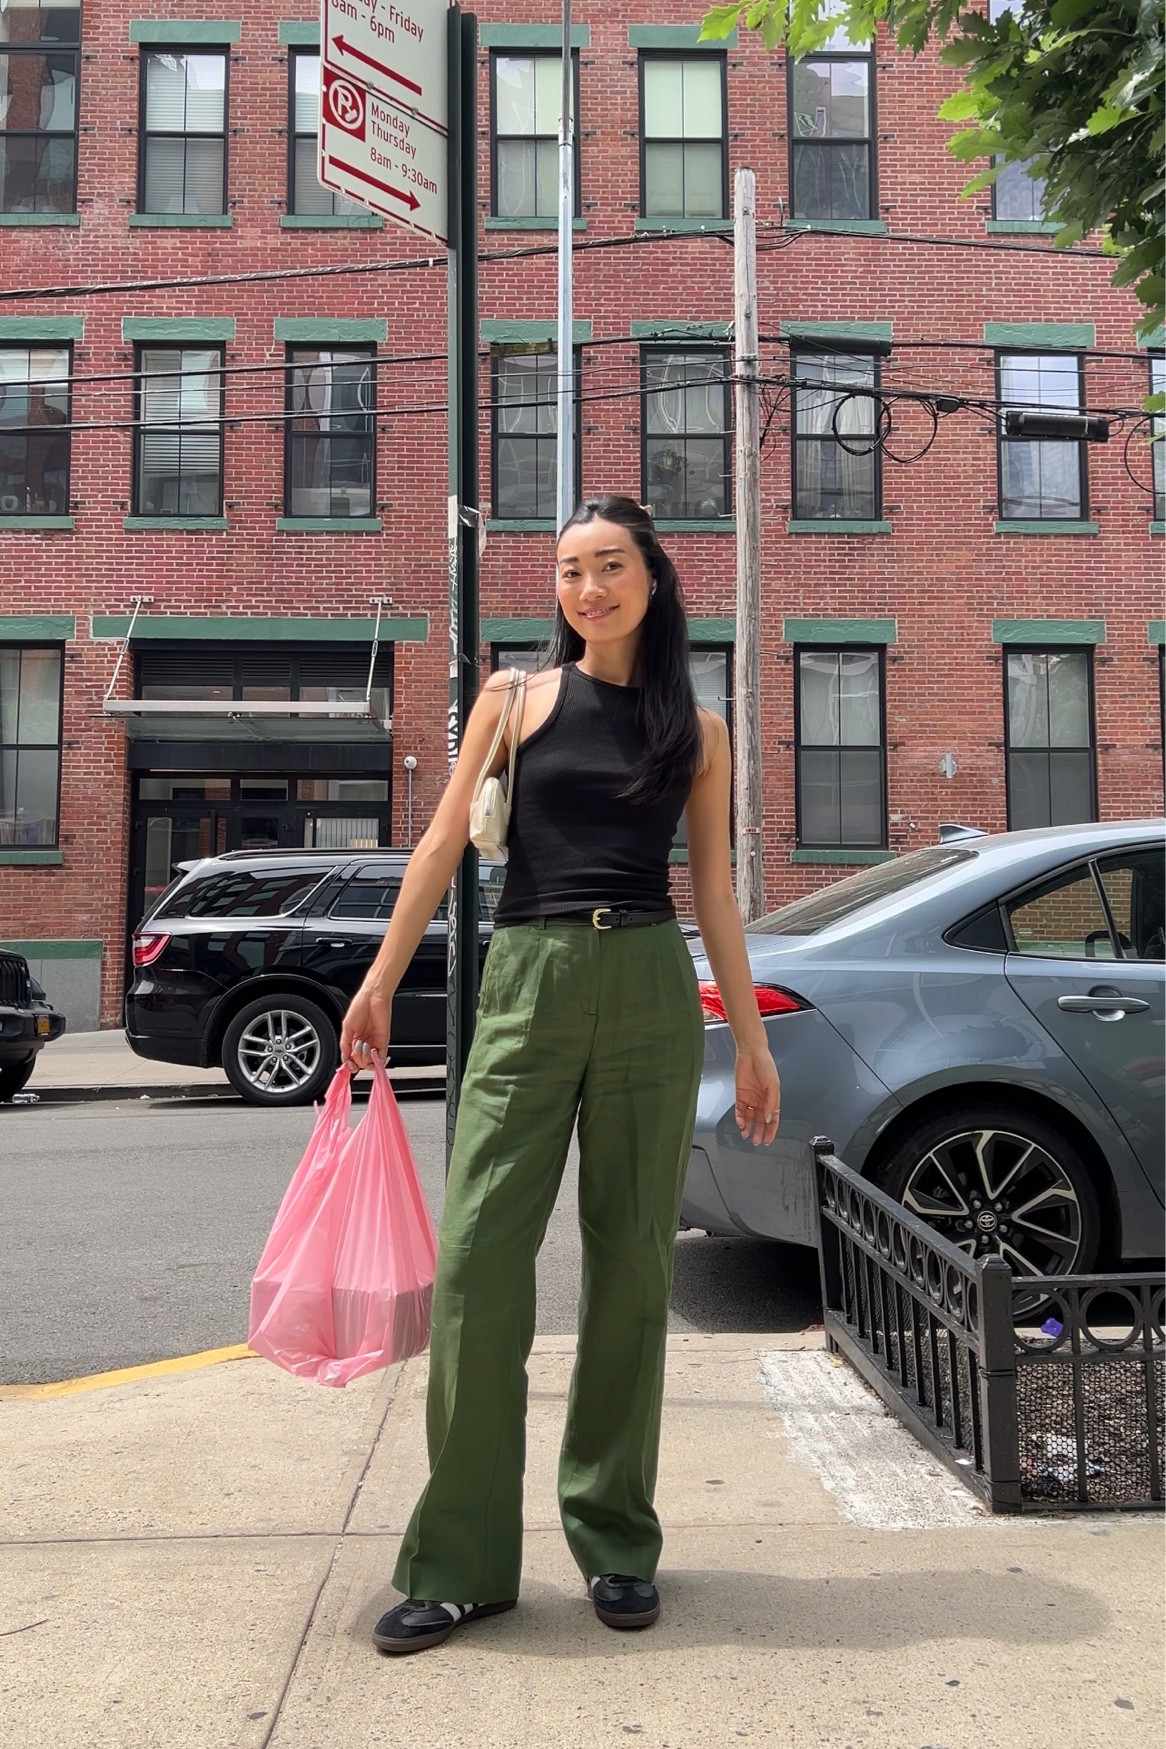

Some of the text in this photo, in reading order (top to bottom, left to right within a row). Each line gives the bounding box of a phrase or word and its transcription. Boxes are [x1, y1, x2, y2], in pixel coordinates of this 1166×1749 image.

[370, 15, 395, 43] 6pm
[390, 5, 424, 43] Friday
[371, 102, 410, 138] Monday
[371, 120, 417, 159] Thursday
[370, 147, 392, 171] 8am
[401, 163, 438, 194] 9:30am
